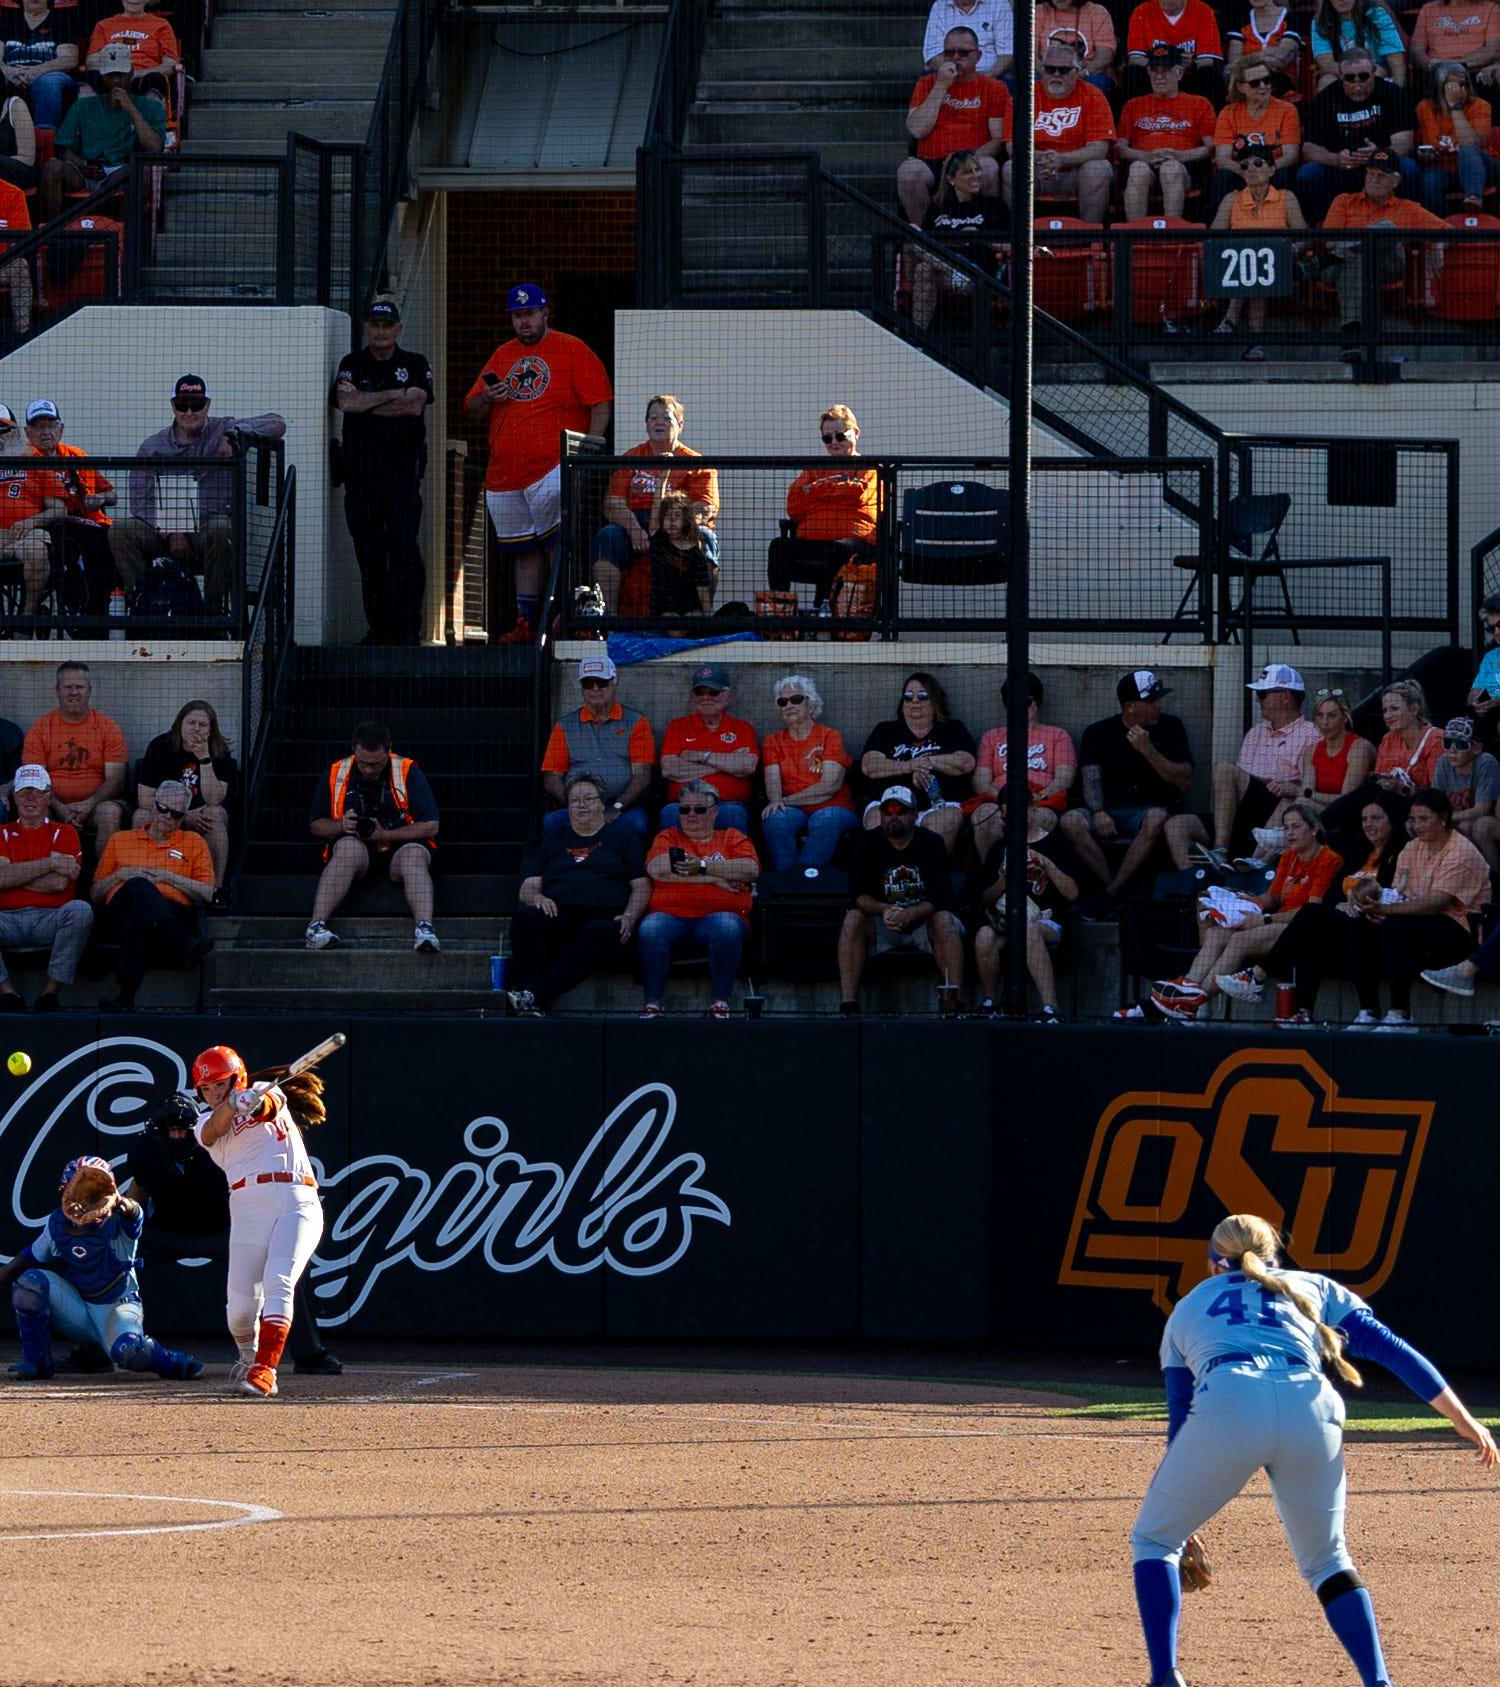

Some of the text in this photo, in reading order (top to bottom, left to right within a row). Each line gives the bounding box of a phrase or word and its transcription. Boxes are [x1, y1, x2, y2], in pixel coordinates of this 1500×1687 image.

[1033, 106, 1082, 138] OSU
[1221, 247, 1276, 289] 203
[8, 482, 21, 499] 9
[1058, 1048, 1437, 1312] OSU
